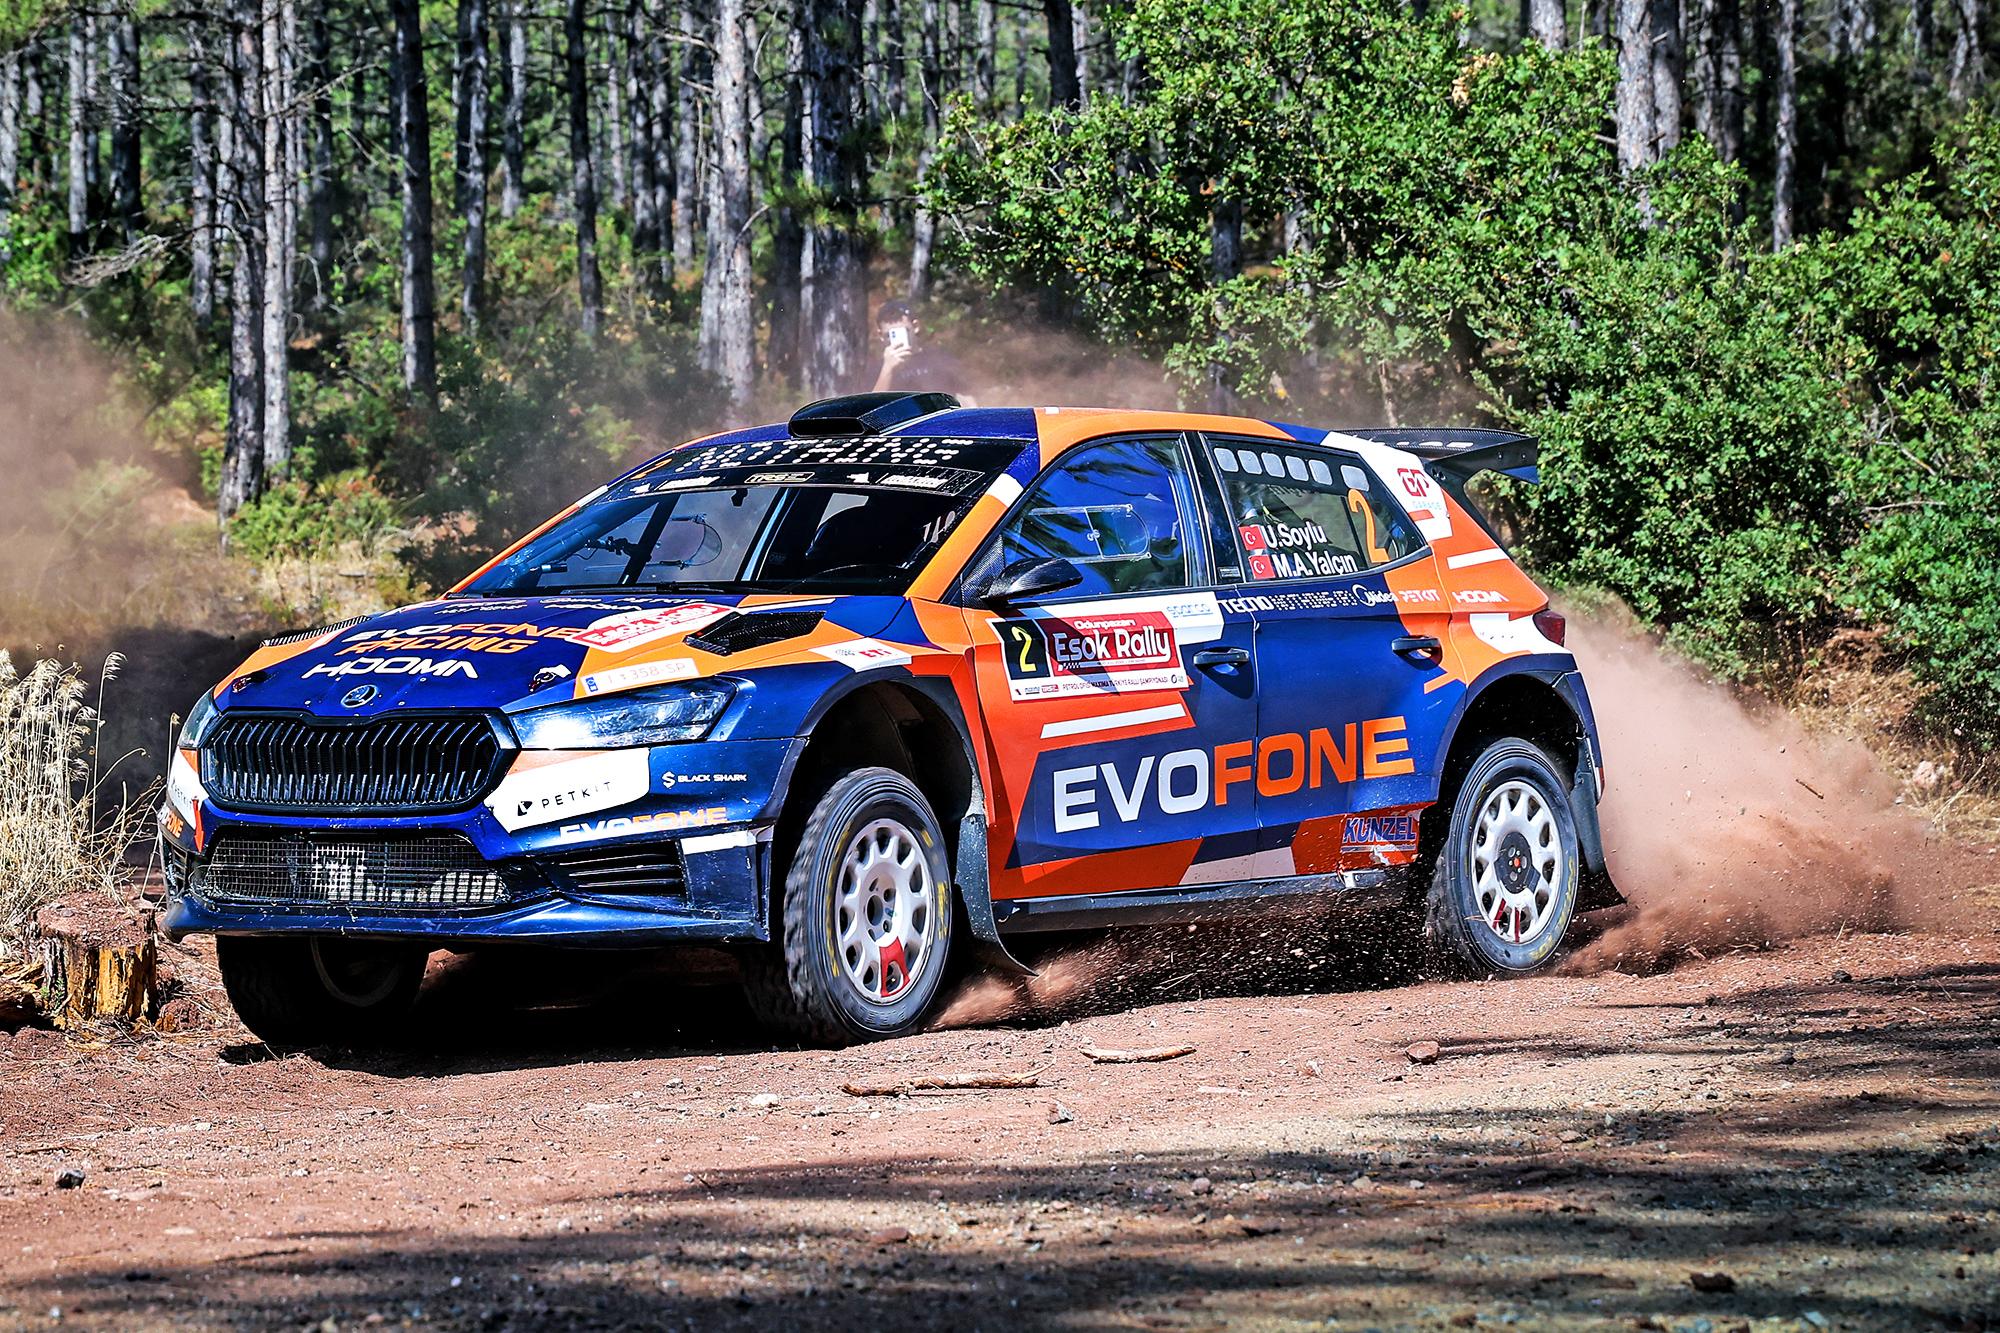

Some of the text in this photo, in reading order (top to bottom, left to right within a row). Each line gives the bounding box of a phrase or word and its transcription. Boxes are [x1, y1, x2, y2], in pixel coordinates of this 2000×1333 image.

[1411, 500, 1443, 510] GARAGE
[1260, 521, 1328, 551] U.Soylu
[1347, 488, 1391, 564] 2
[1271, 550, 1359, 579] M.A.Yalçın
[1217, 596, 1275, 614] TECNO
[1357, 586, 1399, 605] Midea
[1398, 589, 1441, 603] PETKIT
[1452, 590, 1510, 603] HOOMA
[1166, 603, 1211, 616] sparco
[341, 623, 585, 643] EVOFONE
[333, 635, 539, 656] RACING
[1010, 625, 1037, 673] 2
[1053, 626, 1172, 662] Esok Rally
[300, 656, 480, 679] HOOMA
[677, 774, 748, 783] BLACK SHARK
[1053, 715, 1416, 834] EVOFONE
[541, 781, 612, 809] PETKIT
